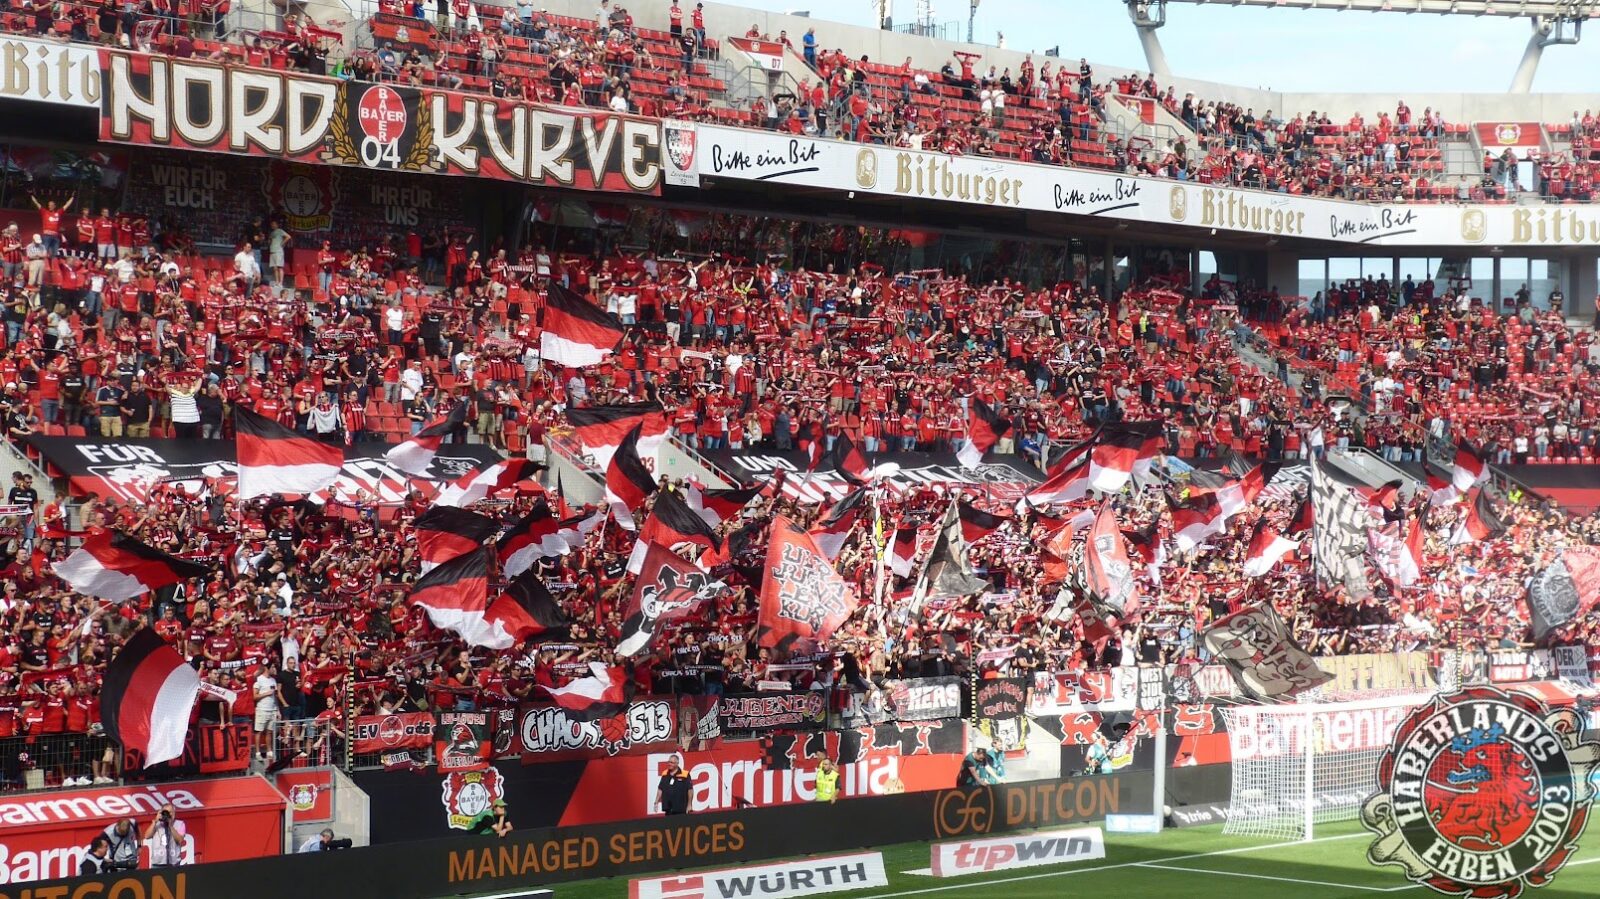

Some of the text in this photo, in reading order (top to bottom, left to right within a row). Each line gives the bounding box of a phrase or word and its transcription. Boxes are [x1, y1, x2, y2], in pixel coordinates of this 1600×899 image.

[112, 56, 660, 190] NORD KURVE
[360, 107, 404, 122] BAYER
[378, 88, 388, 143] BAYER
[361, 136, 401, 169] 04
[711, 139, 821, 173] Bitte ein Bit
[151, 164, 228, 190] WIR FÜR
[895, 153, 1024, 206] Bitburger
[1053, 178, 1141, 210] Bitte ein Bit
[165, 186, 214, 209] EUCH
[371, 184, 432, 208] IHR FÜR
[1201, 188, 1306, 235] Bitburger
[385, 206, 419, 226] UNS
[1331, 208, 1417, 238] Bitte ein Bit
[75, 444, 167, 464] FÜR
[732, 455, 797, 472] UND
[628, 701, 672, 745] 513
[0, 787, 203, 824] armenia
[1006, 778, 1120, 826] DITCON
[448, 821, 745, 882] MANAGED SERVICES
[953, 837, 1093, 871] tipwin
[715, 862, 867, 899] WÜRTH
